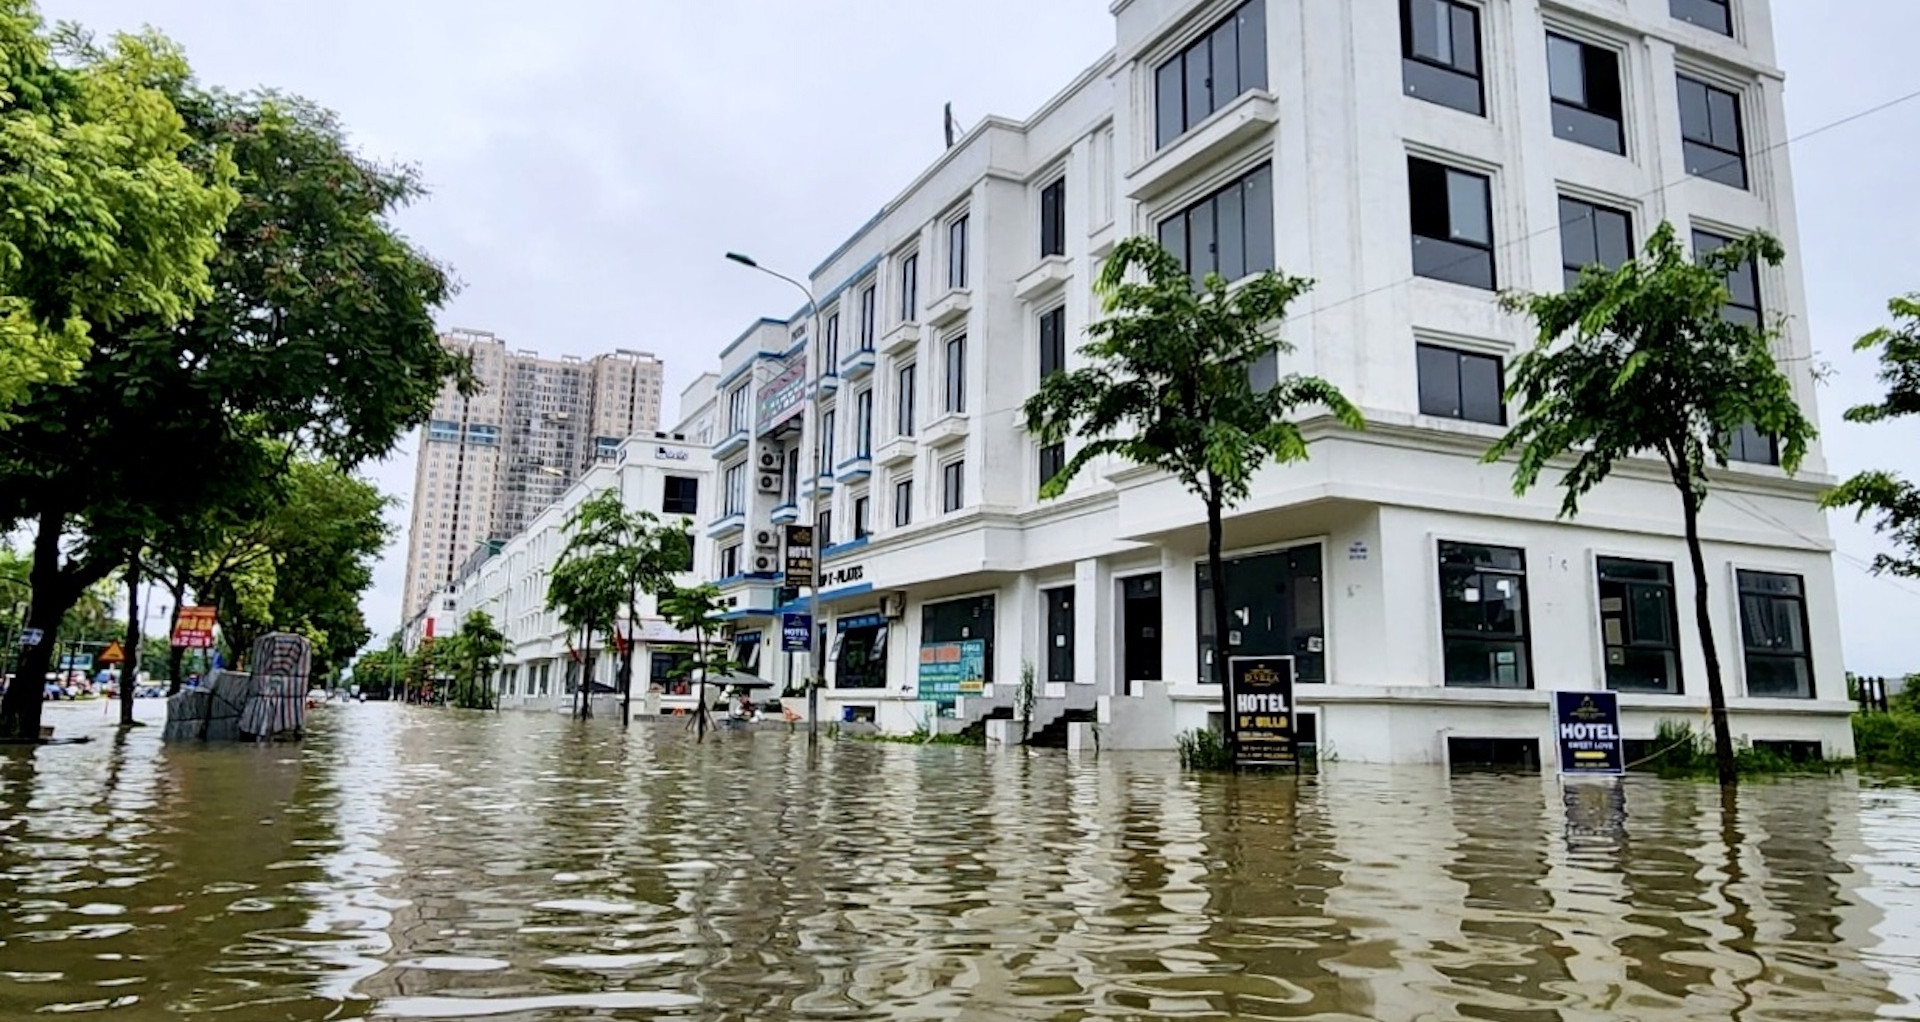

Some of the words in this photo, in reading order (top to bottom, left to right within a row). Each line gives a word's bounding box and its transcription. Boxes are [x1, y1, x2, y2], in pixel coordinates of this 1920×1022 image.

[784, 628, 809, 637] HOTEL
[1237, 693, 1289, 713] HOTEL
[1560, 722, 1618, 740] HOTEL
[1568, 741, 1593, 750] SWEET
[1594, 742, 1614, 750] LOVE
